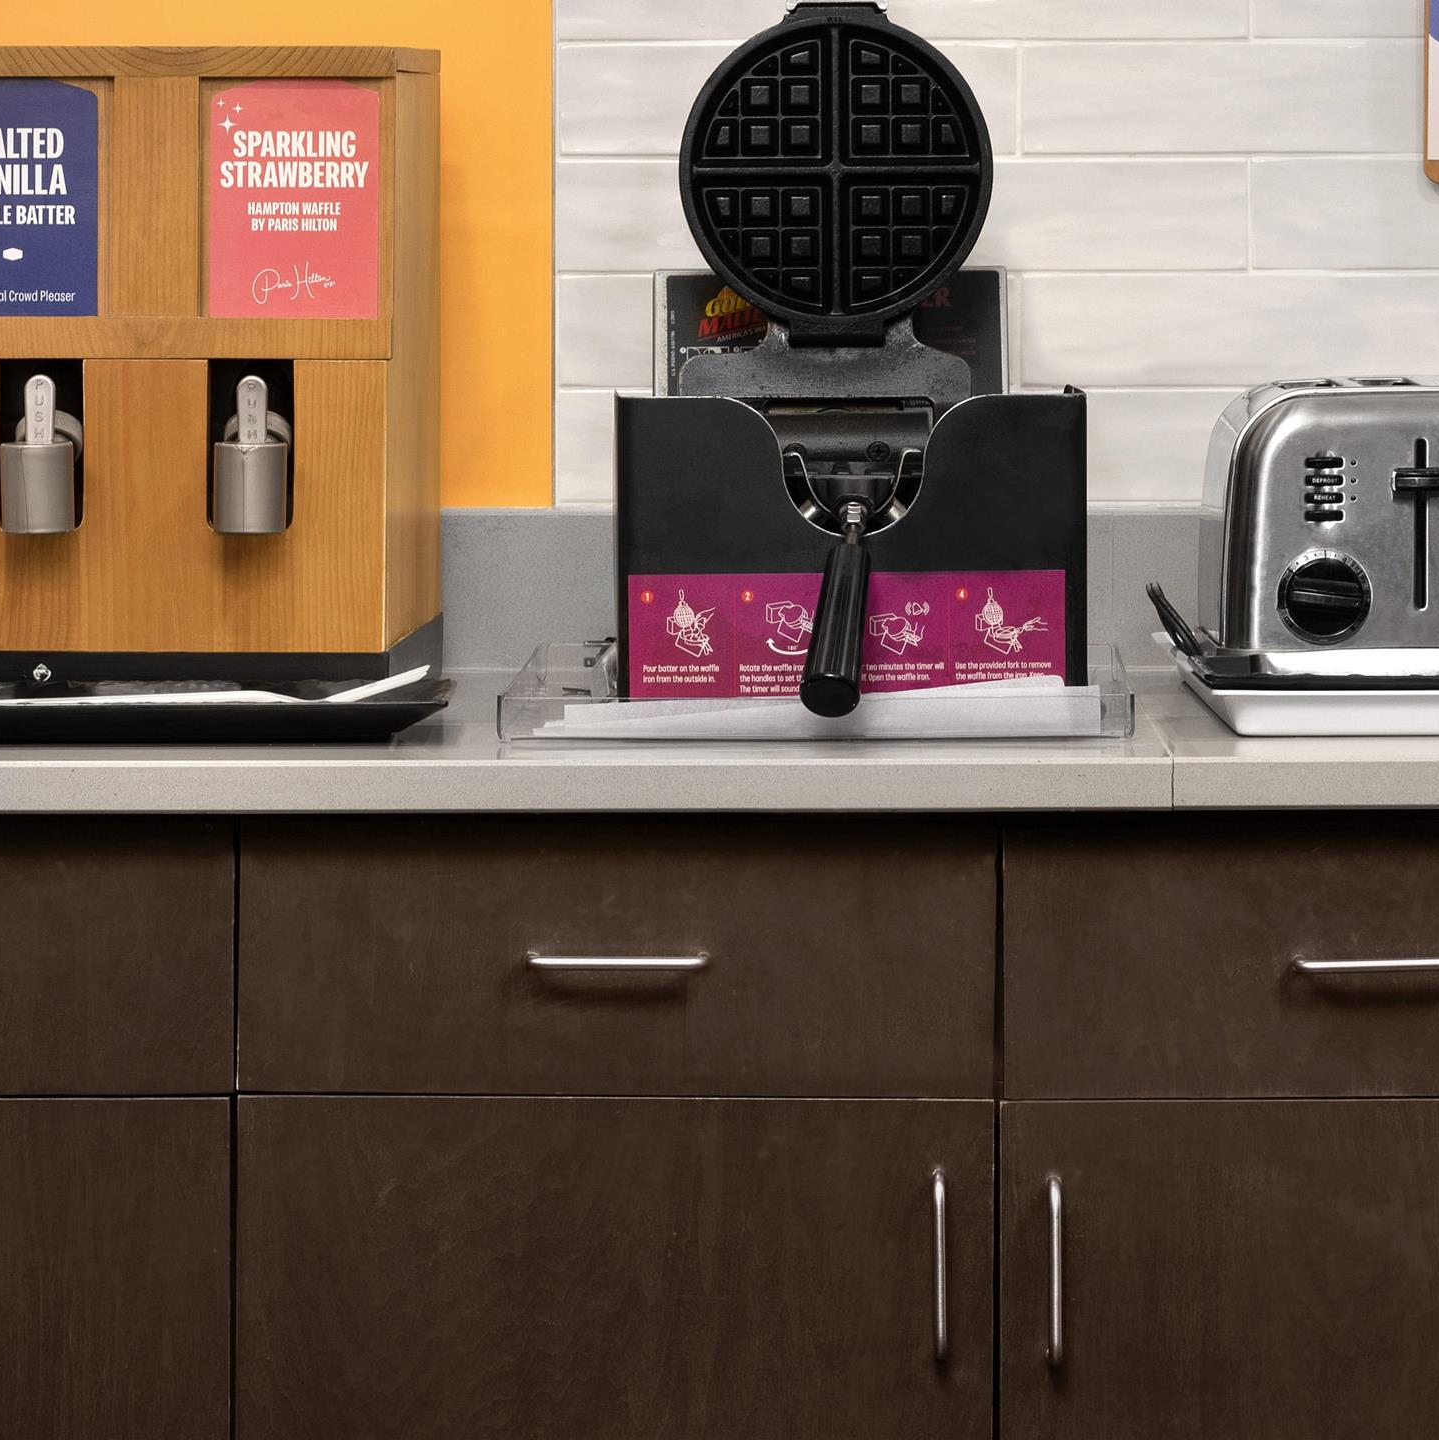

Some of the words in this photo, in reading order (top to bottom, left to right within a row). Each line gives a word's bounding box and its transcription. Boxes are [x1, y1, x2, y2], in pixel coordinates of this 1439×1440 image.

[233, 130, 356, 158] SPARKLING
[220, 160, 369, 188] STRAWBERRY
[247, 201, 299, 216] HAMPTON
[302, 201, 341, 216] WAFFLE
[15, 204, 76, 225] BATTER
[251, 218, 266, 232] BY
[268, 217, 299, 232] PARIS
[301, 217, 338, 232] HILTON
[252, 268, 292, 304] Paris
[290, 260, 331, 300] Hilton
[9, 289, 39, 303] Crowd
[40, 289, 76, 303] Pleaser
[34, 379, 44, 440] PUSH
[643, 664, 657, 672] Pour
[658, 664, 678, 672] batter
[689, 664, 699, 672] the
[700, 664, 720, 672] waffle
[739, 664, 760, 672] Rotate
[761, 664, 772, 672] the
[773, 664, 792, 672] waffle
[866, 663, 877, 671] two
[878, 662, 903, 670] minutes
[905, 662, 915, 670] the
[916, 662, 933, 670] timer
[934, 661, 944, 670] will
[955, 661, 966, 670] Use
[967, 661, 978, 669] the
[979, 661, 1006, 671] provided
[1007, 661, 1019, 669] fork
[643, 675, 655, 683] iron
[656, 675, 671, 683] from
[672, 675, 683, 683] the
[684, 675, 707, 683] outside
[708, 675, 716, 683] in.
[740, 674, 750, 682] the
[751, 674, 776, 682] handles
[868, 673, 884, 683] Open
[885, 673, 896, 681] the
[897, 673, 916, 681] waffle
[917, 672, 930, 681] iron.
[955, 672, 966, 680] the
[967, 671, 986, 680] waffle
[987, 671, 1002, 679] from
[1003, 671, 1014, 679] the
[740, 685, 751, 693] The
[752, 685, 769, 693] timer
[770, 685, 780, 693] will
[781, 685, 800, 693] sound
